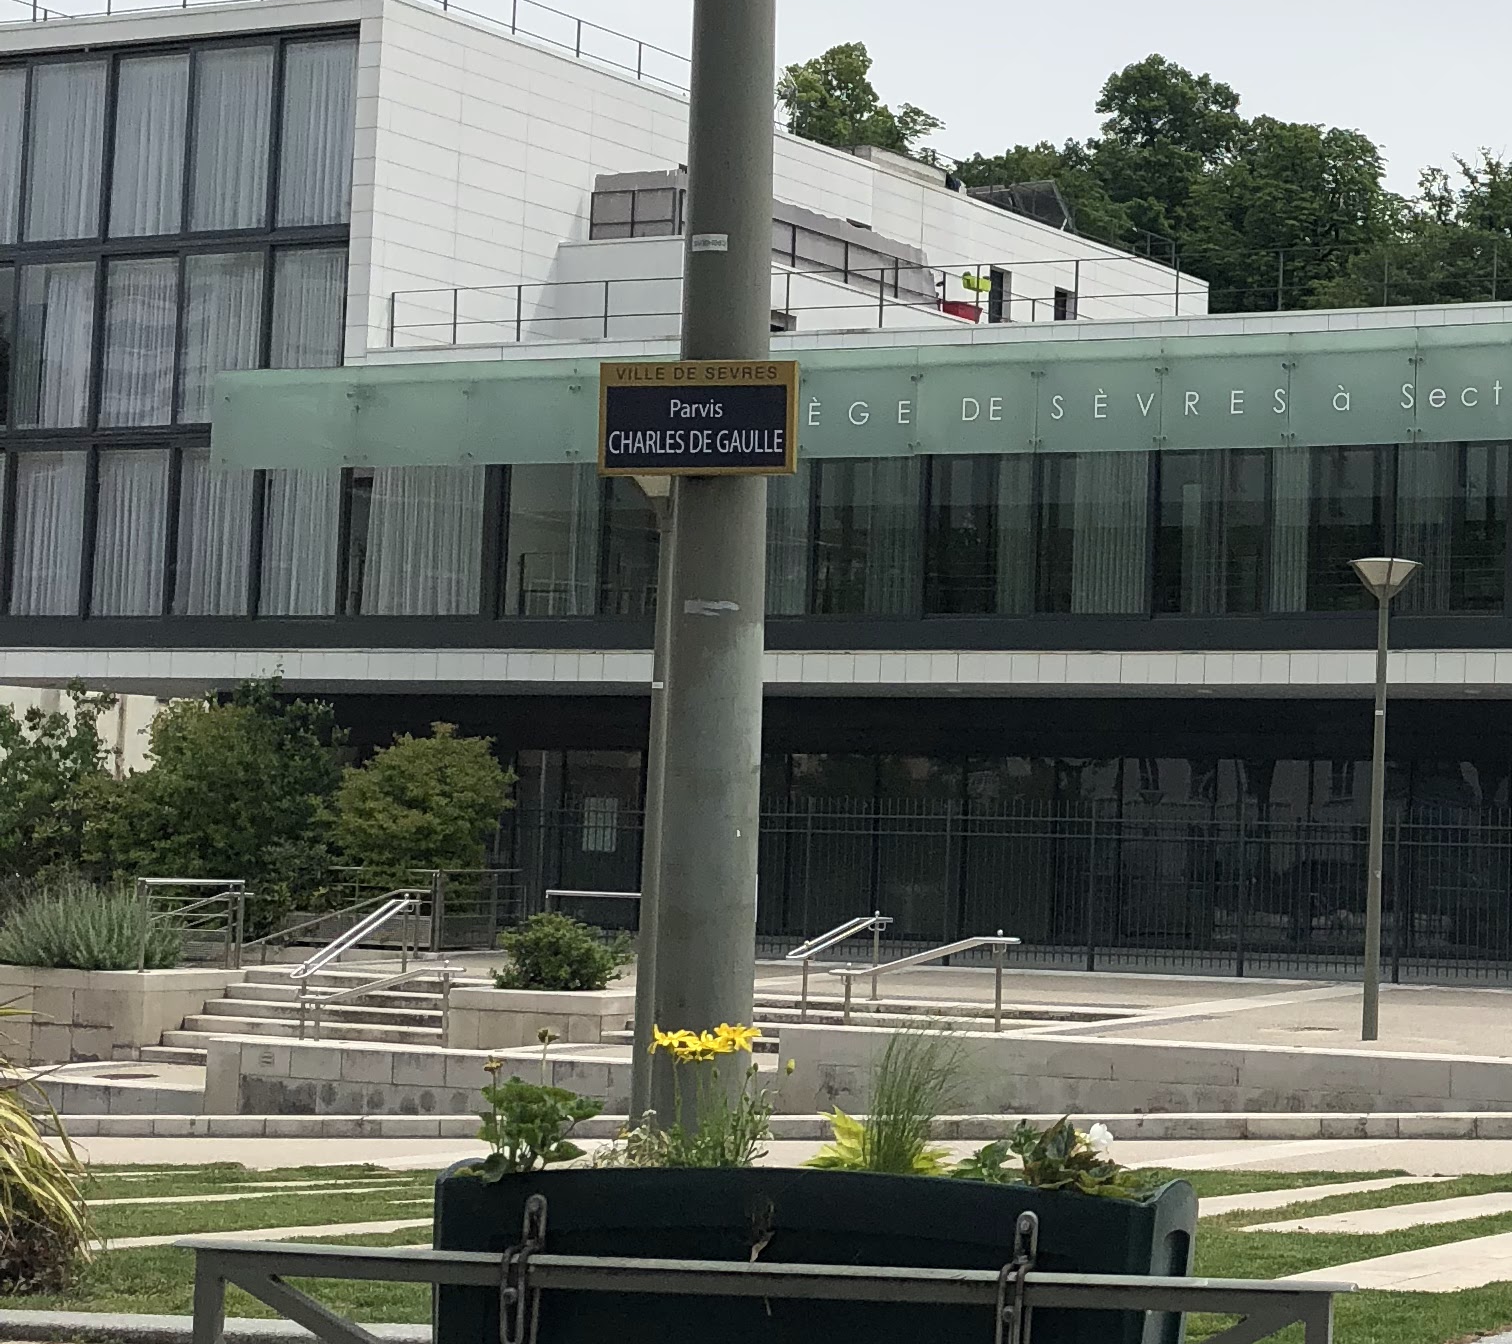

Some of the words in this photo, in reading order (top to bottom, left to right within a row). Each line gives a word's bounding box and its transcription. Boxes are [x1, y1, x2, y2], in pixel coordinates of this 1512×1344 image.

[616, 367, 666, 381] VILLE
[673, 367, 697, 381] DE
[704, 365, 778, 380] SEVRES
[669, 398, 723, 418] Parvis
[961, 397, 1003, 421] DE
[1050, 388, 1287, 420] SÈVRES
[1332, 385, 1351, 411] à
[608, 430, 685, 454] CHARLES
[689, 430, 712, 454] DE
[716, 429, 784, 453] GAULLE
